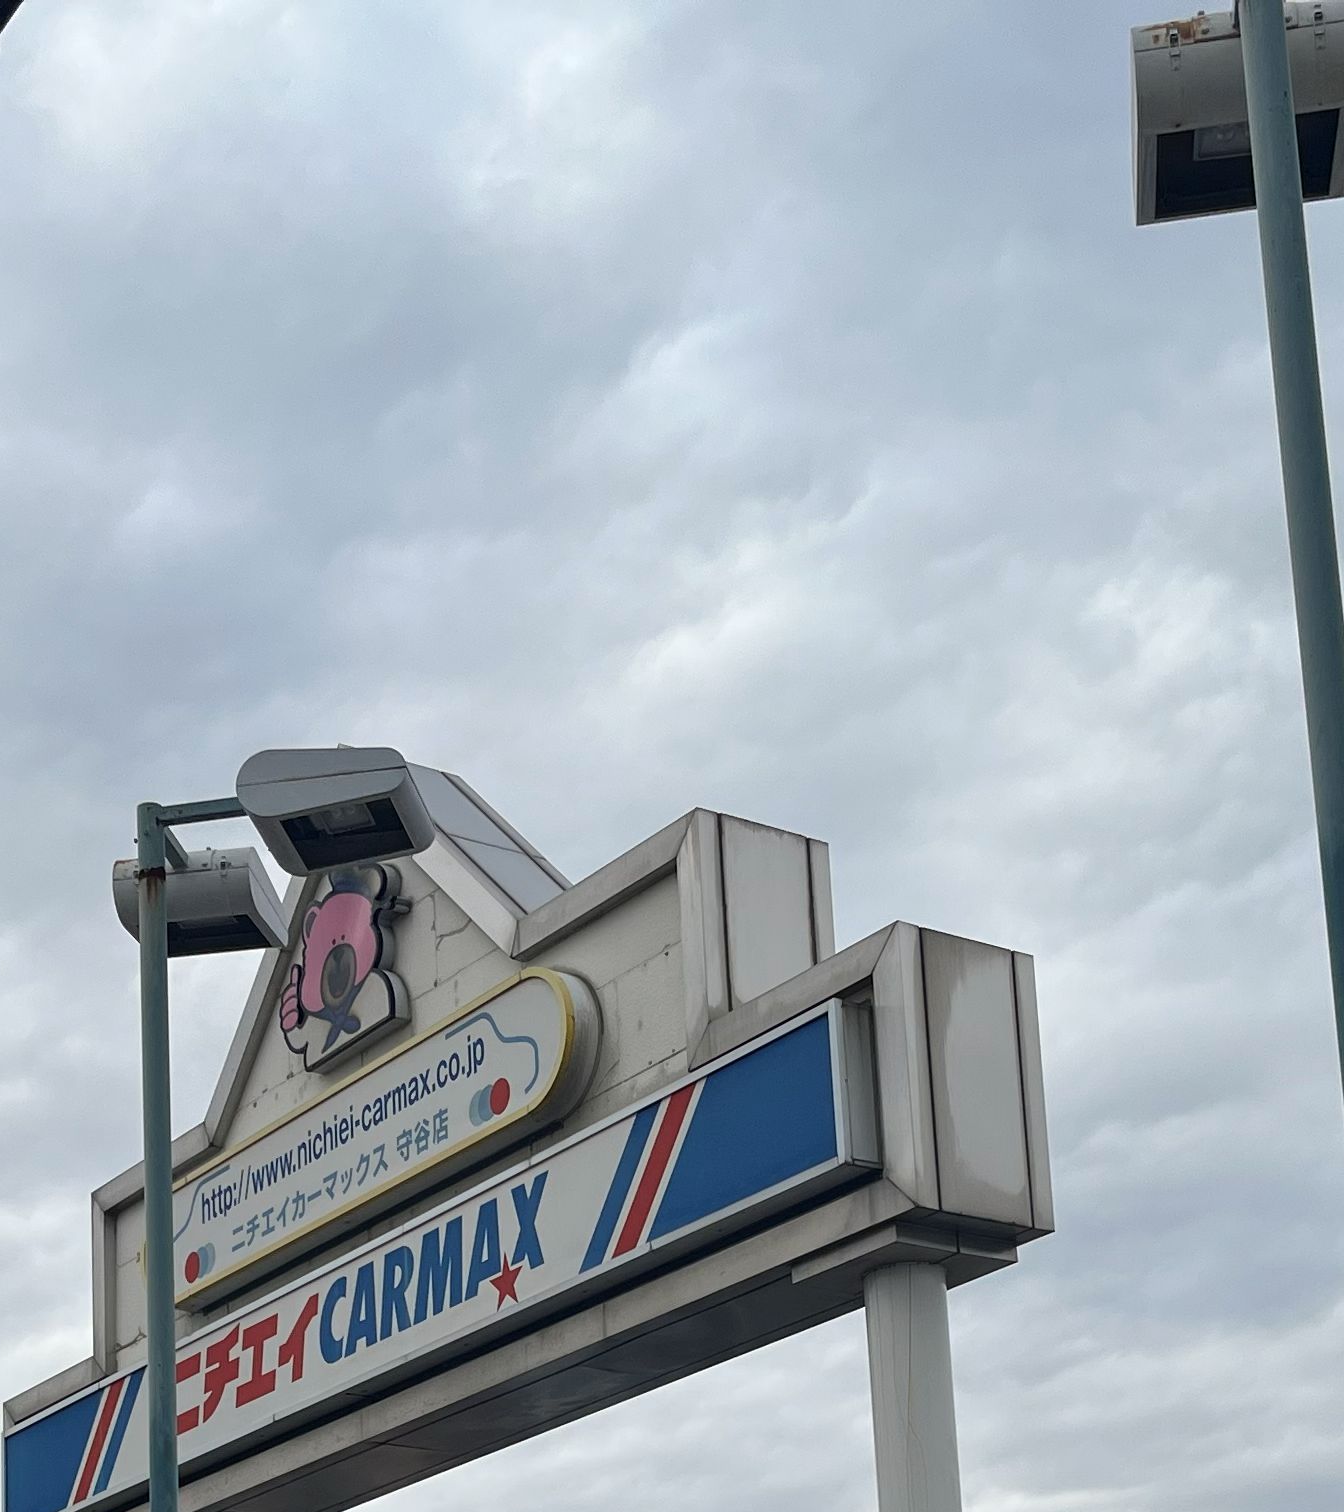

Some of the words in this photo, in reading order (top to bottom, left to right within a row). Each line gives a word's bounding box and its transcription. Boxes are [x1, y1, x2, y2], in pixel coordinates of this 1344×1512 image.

[201, 1033, 487, 1226] http://www.nichiei-carmax.co.jp
[230, 1148, 389, 1254] ニチエイカーマックス
[396, 1107, 450, 1161] 守谷店
[317, 1170, 549, 1366] CARMAX
